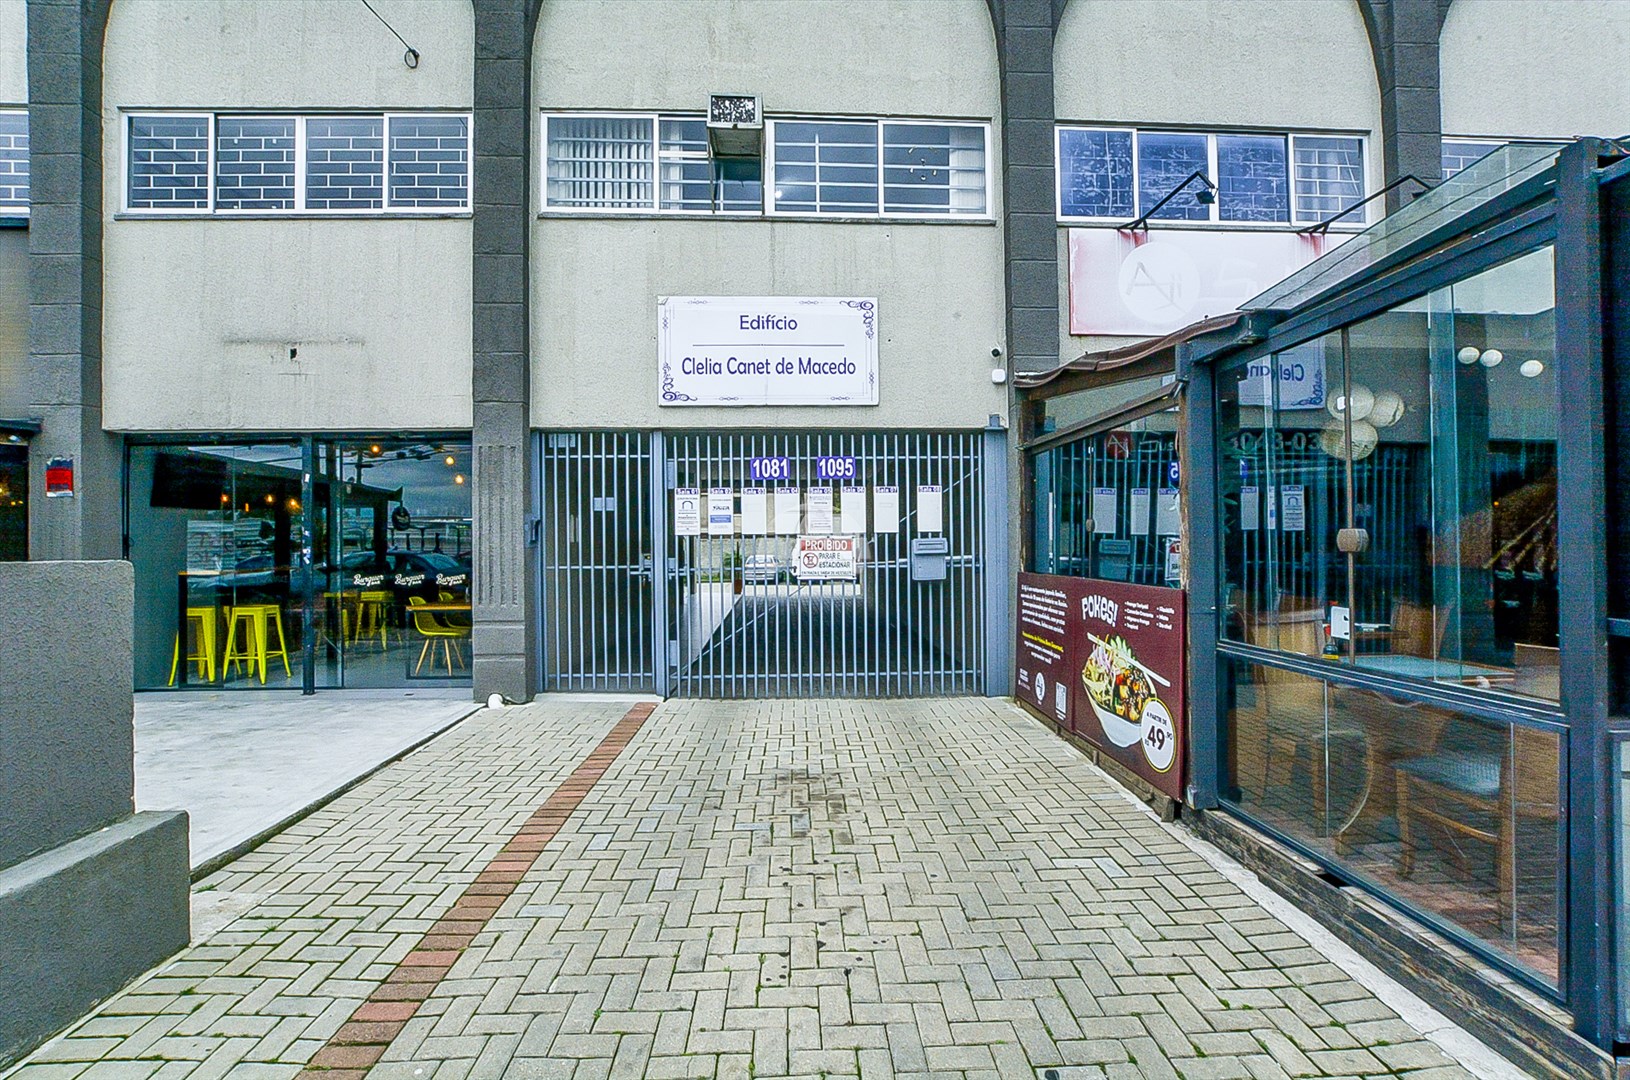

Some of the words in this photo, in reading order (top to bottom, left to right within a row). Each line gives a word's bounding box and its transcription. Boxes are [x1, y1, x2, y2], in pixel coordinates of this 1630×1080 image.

[739, 314, 798, 331] Edifício
[681, 356, 723, 375] Clelia
[726, 356, 770, 375] Canet
[775, 357, 794, 375] de
[798, 356, 856, 375] Macedo
[752, 459, 790, 479] 1081
[818, 458, 854, 478] 1095
[805, 539, 848, 551] PROIBIDO
[1147, 725, 1165, 750] 49
